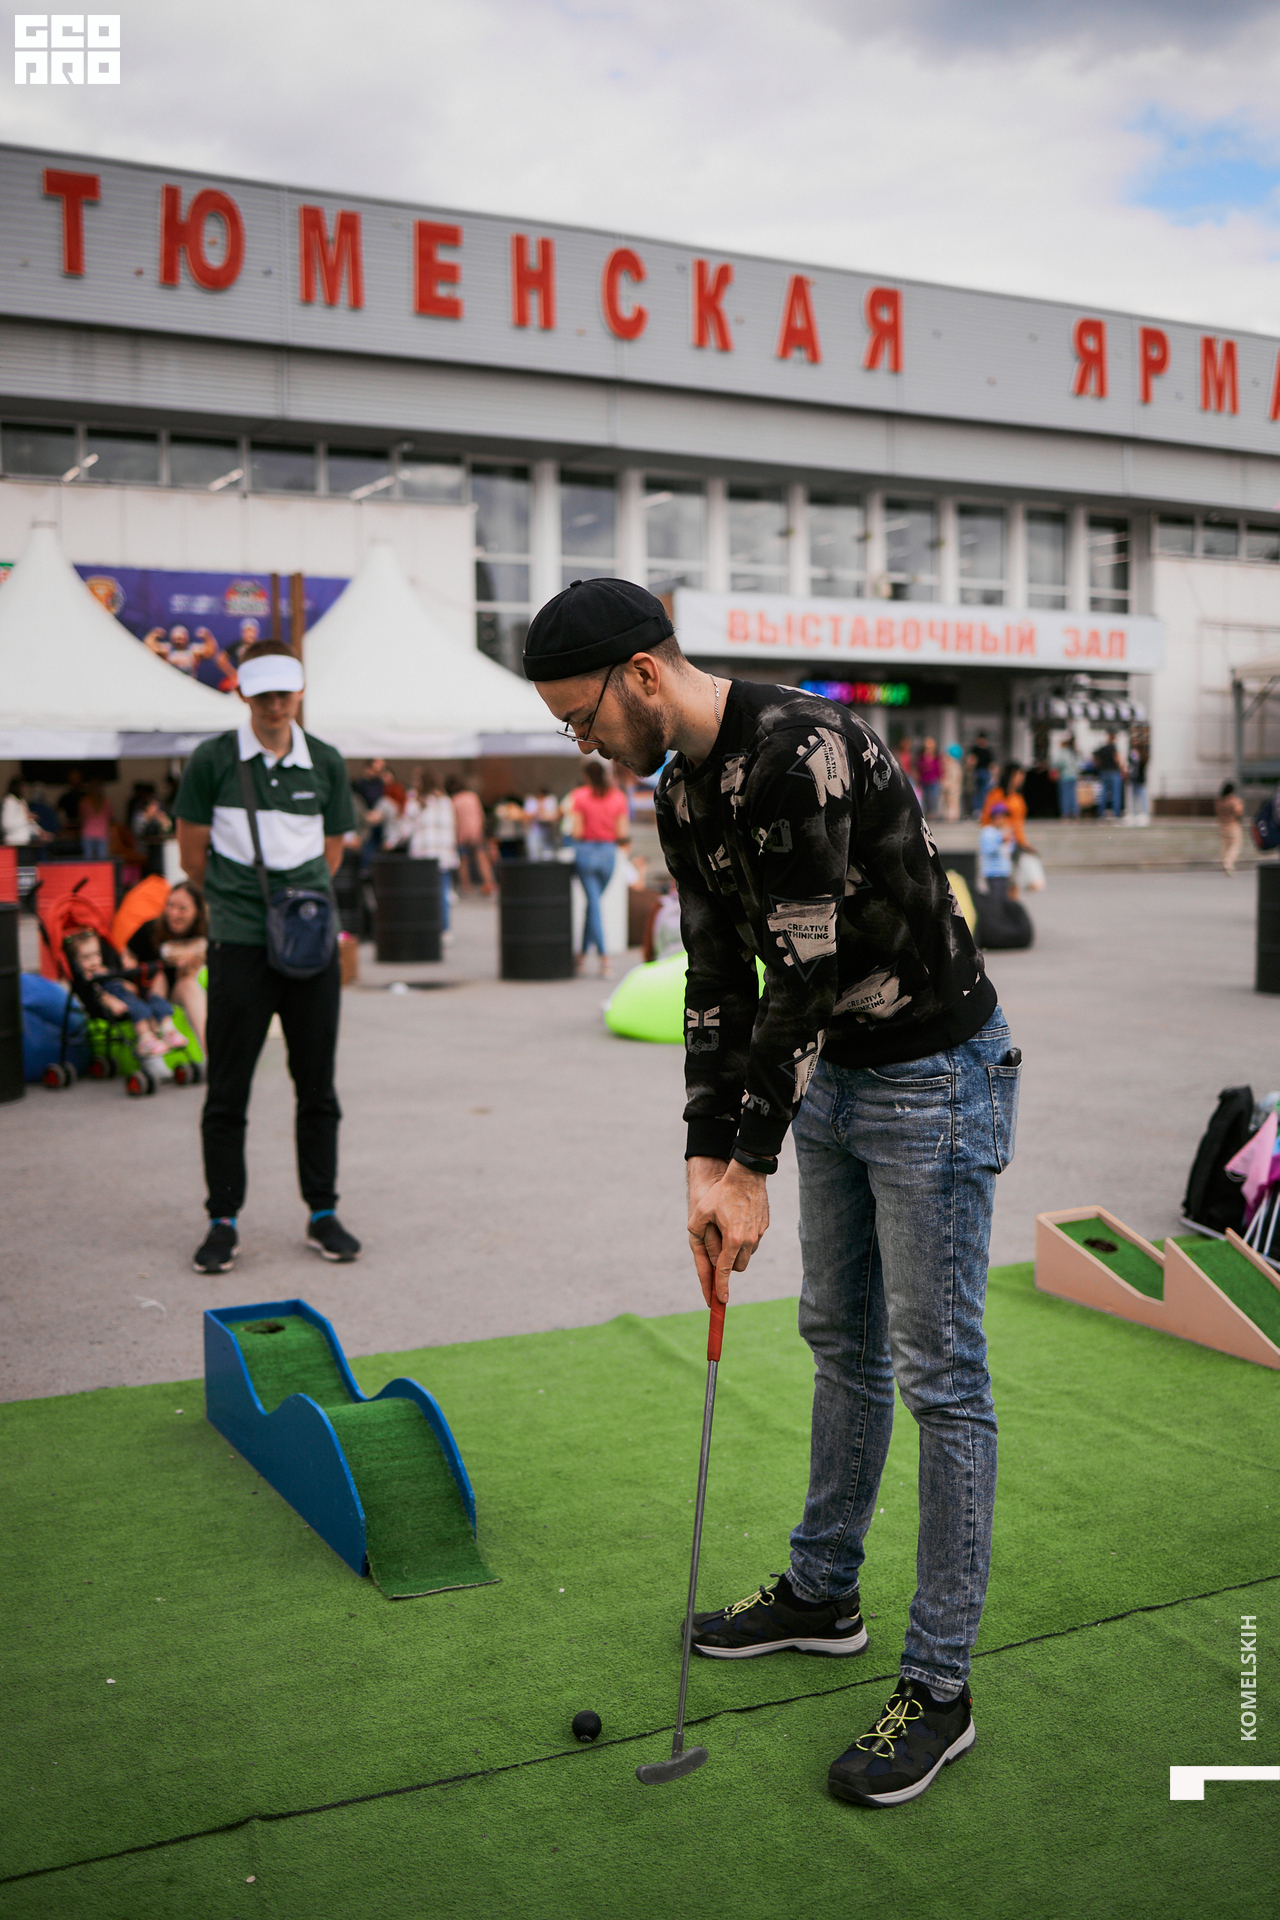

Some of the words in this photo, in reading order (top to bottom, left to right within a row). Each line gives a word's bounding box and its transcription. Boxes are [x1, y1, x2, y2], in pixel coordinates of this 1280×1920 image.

[43, 168, 904, 373] ТЮМЕНСКАЯ
[1072, 317, 1280, 422] ЯРМ
[727, 609, 1037, 656] ВЫСТАВОЧНЫЙ
[1063, 626, 1127, 660] ЗАЛ
[822, 743, 833, 780] THINKING
[827, 742, 837, 779] CREATIVE
[787, 923, 829, 932] CREATIVE
[788, 930, 829, 940] THINKING
[847, 991, 883, 1008] CREATIVE
